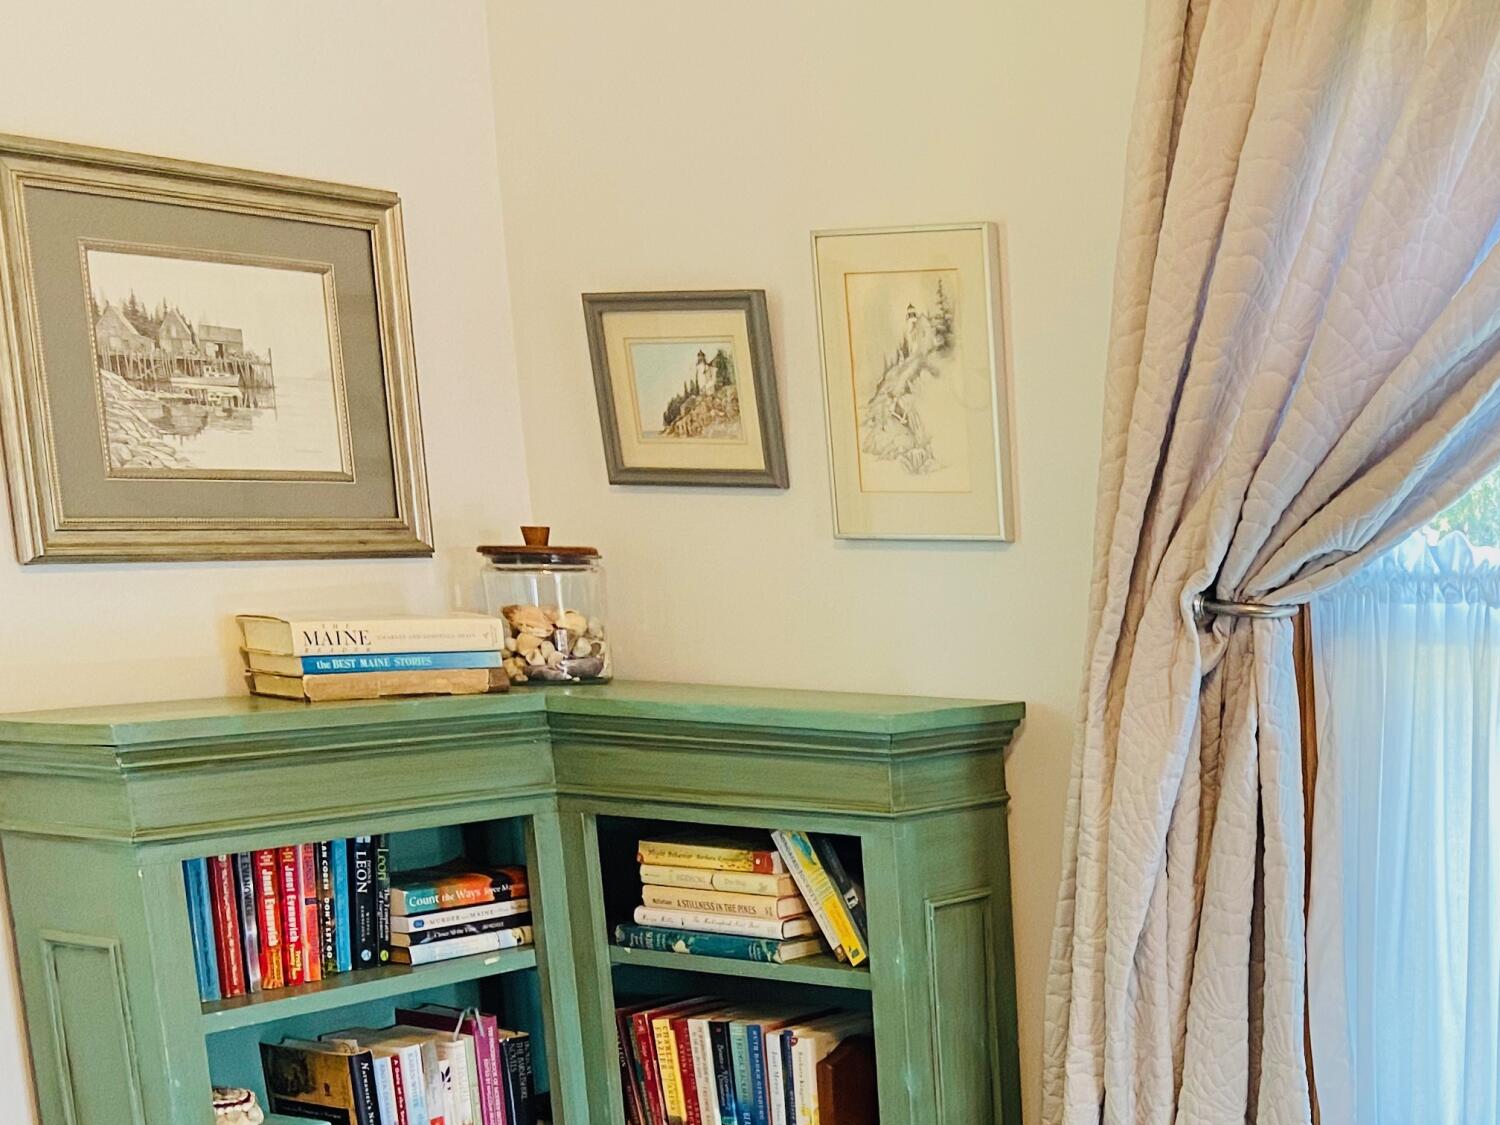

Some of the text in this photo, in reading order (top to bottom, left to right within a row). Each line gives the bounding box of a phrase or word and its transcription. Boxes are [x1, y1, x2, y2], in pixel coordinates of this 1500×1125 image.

[303, 630, 371, 646] MAINE
[316, 656, 432, 669] the BEST MAINE STORIES
[320, 860, 329, 889] COBEN
[354, 851, 368, 892] LEON
[377, 848, 388, 880] Leon
[261, 868, 274, 895] Janet
[284, 866, 295, 892] Janet
[323, 897, 331, 924] DON'T
[408, 892, 439, 908] Count
[441, 893, 456, 903] the
[455, 886, 482, 902] Ways
[681, 899, 715, 910] STILLNESS
[715, 903, 723, 911] IN
[723, 903, 736, 912] THE
[737, 904, 757, 914] PINES
[264, 898, 279, 946] Evanovich
[285, 894, 299, 942] Evanovich
[326, 946, 332, 958] GO
